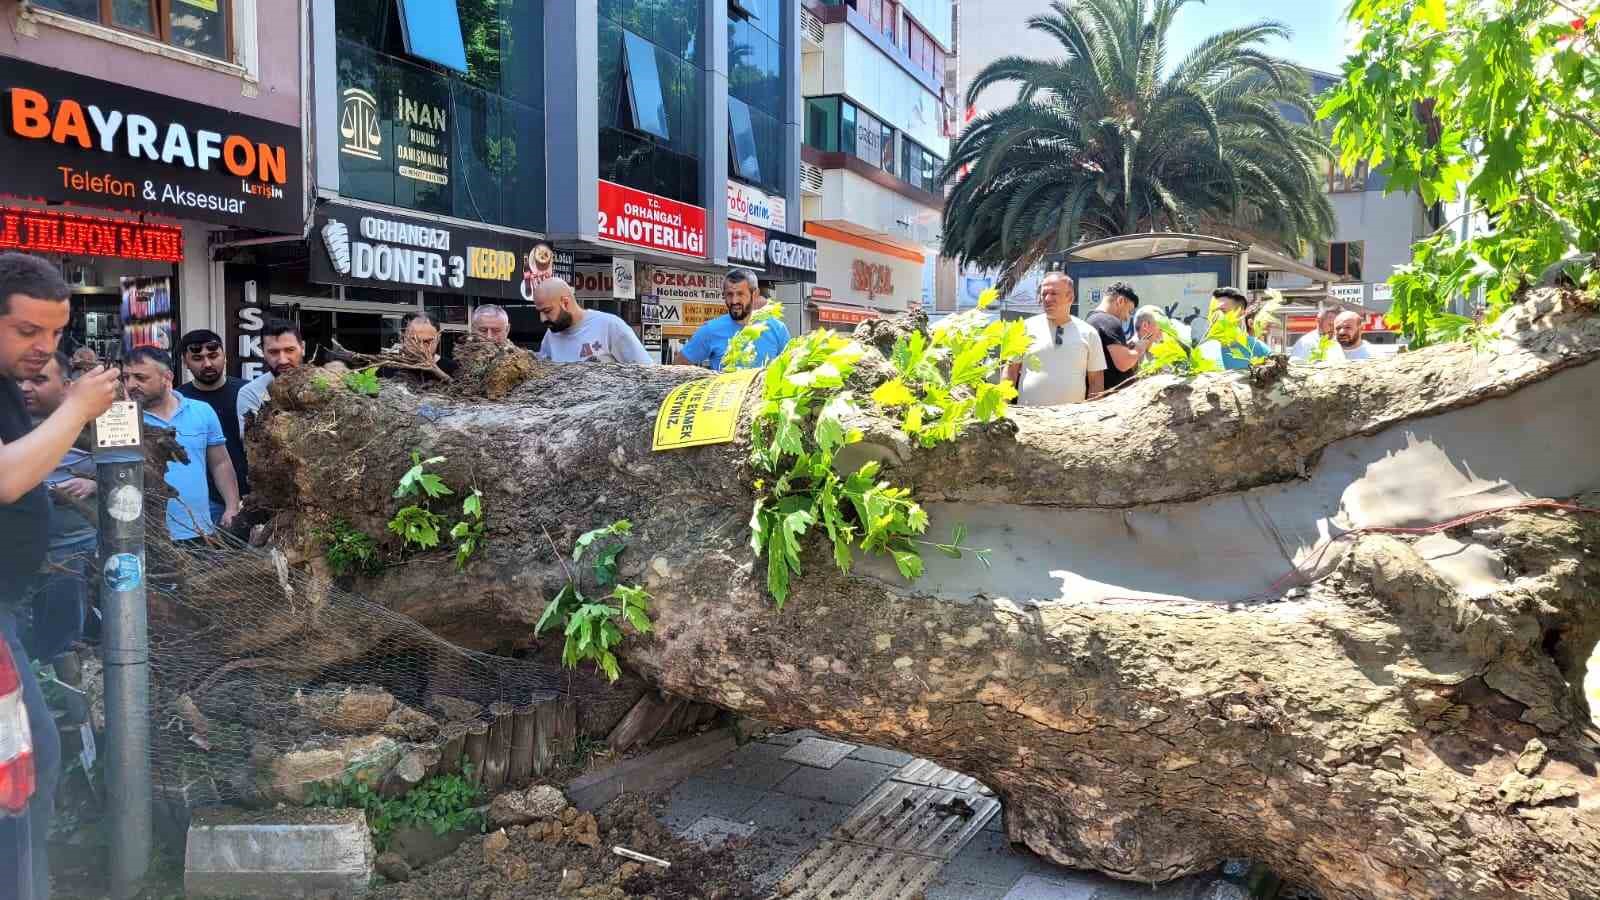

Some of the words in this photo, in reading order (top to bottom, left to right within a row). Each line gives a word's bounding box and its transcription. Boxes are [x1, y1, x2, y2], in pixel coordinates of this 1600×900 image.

[398, 89, 446, 132] İNAN
[11, 87, 288, 184] BAYRAFON
[58, 166, 135, 198] Telefon
[142, 180, 156, 200] &
[161, 183, 247, 215] Aksesuar
[616, 214, 704, 254] NOTERLİĞİ
[624, 202, 682, 227] ORHANGAZİ
[466, 246, 516, 282] KEBAP
[656, 286, 698, 298] Notebook
